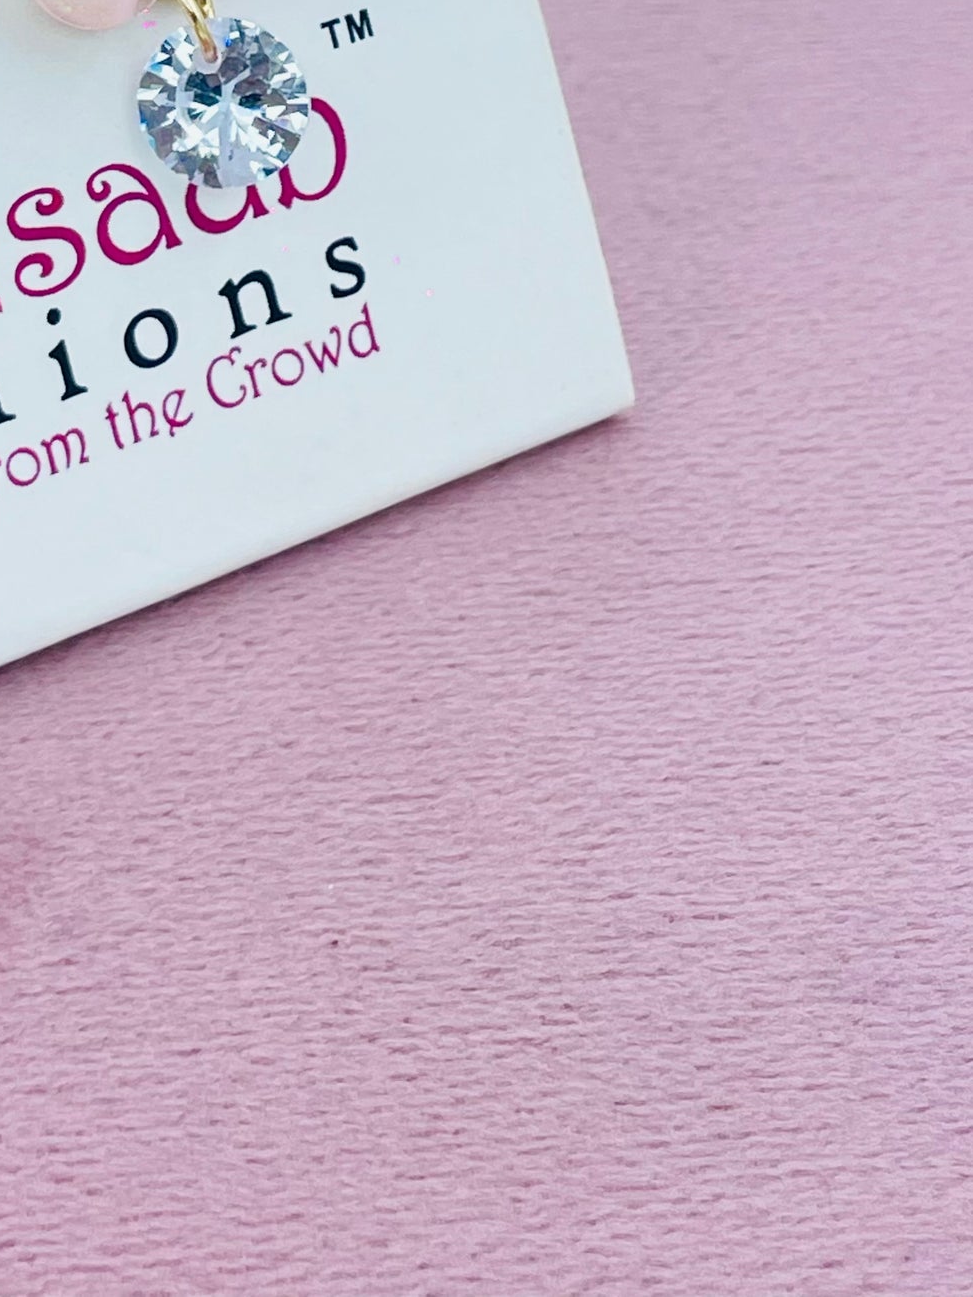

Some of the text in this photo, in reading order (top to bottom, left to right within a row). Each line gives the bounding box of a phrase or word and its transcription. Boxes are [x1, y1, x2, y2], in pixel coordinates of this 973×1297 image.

[320, 8, 375, 49] TM
[104, 390, 194, 451] the
[206, 302, 381, 409] Crowd
